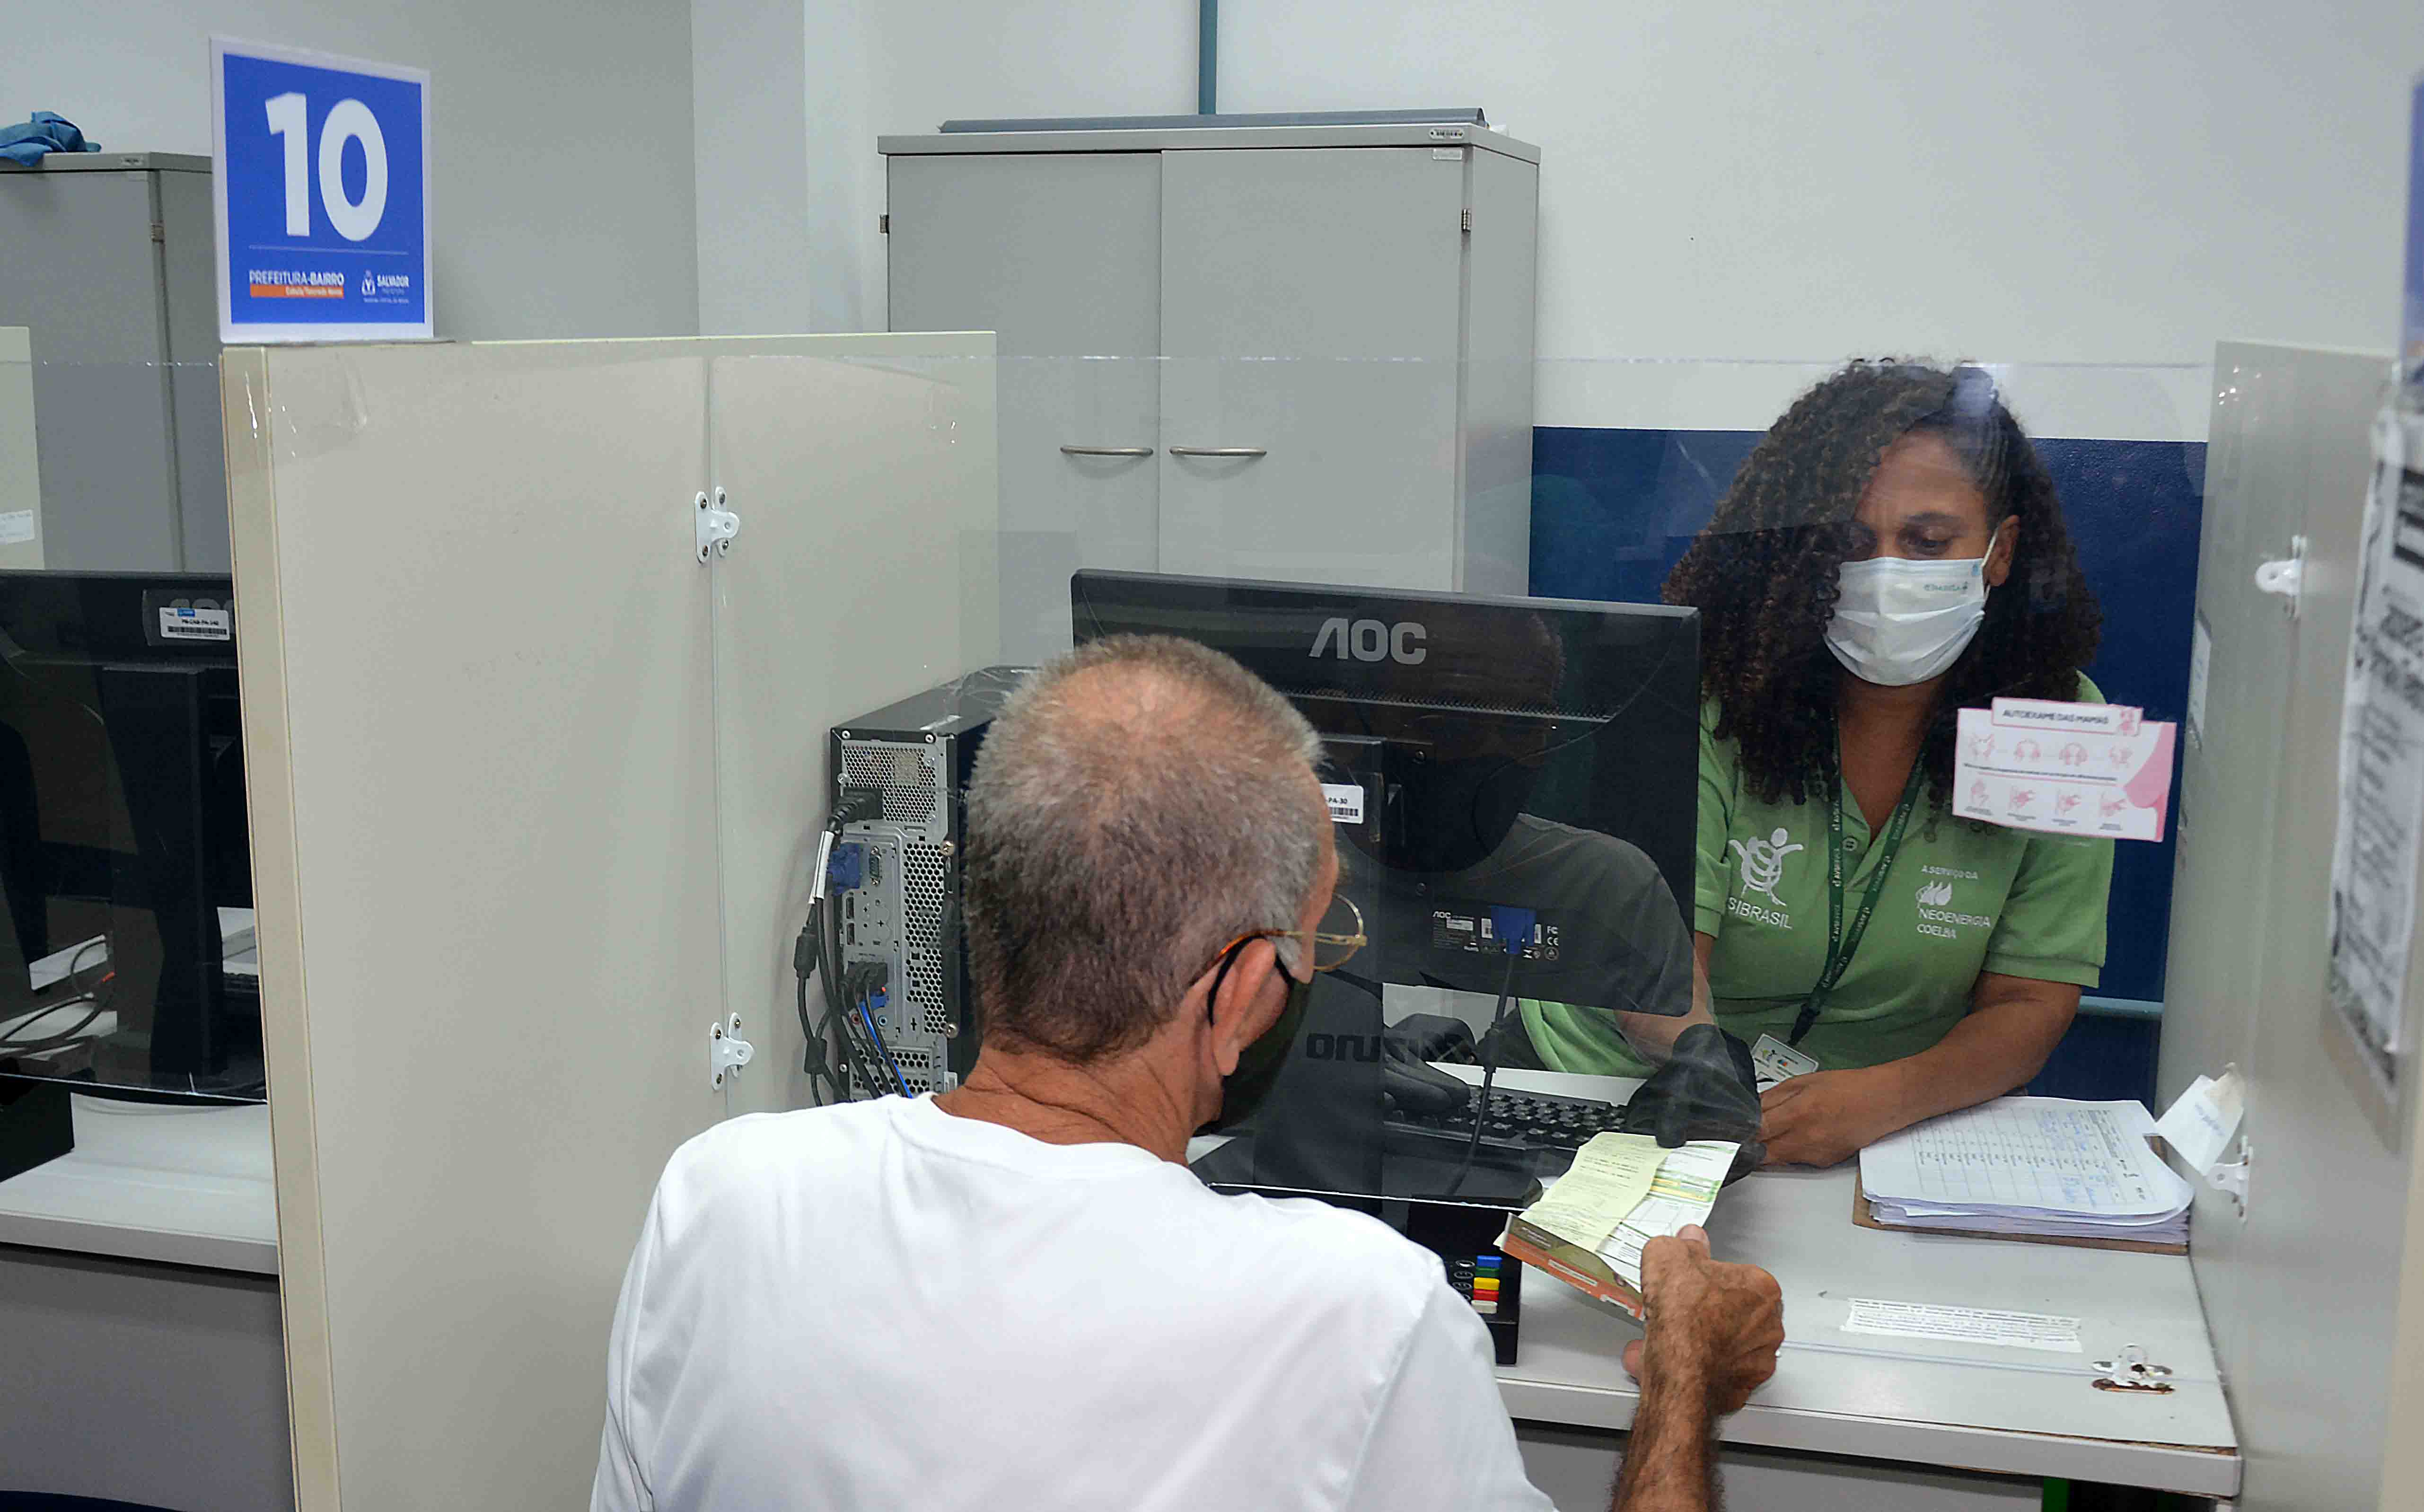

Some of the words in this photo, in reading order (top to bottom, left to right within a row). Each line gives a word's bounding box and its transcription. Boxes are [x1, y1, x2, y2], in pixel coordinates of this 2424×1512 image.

[265, 91, 389, 242] 10
[249, 269, 345, 287] PREFEITURA-BAIRRO
[377, 274, 409, 288] SALVADOR
[1309, 617, 1427, 665] AOC
[1919, 908, 1991, 927] NEOENERGIA
